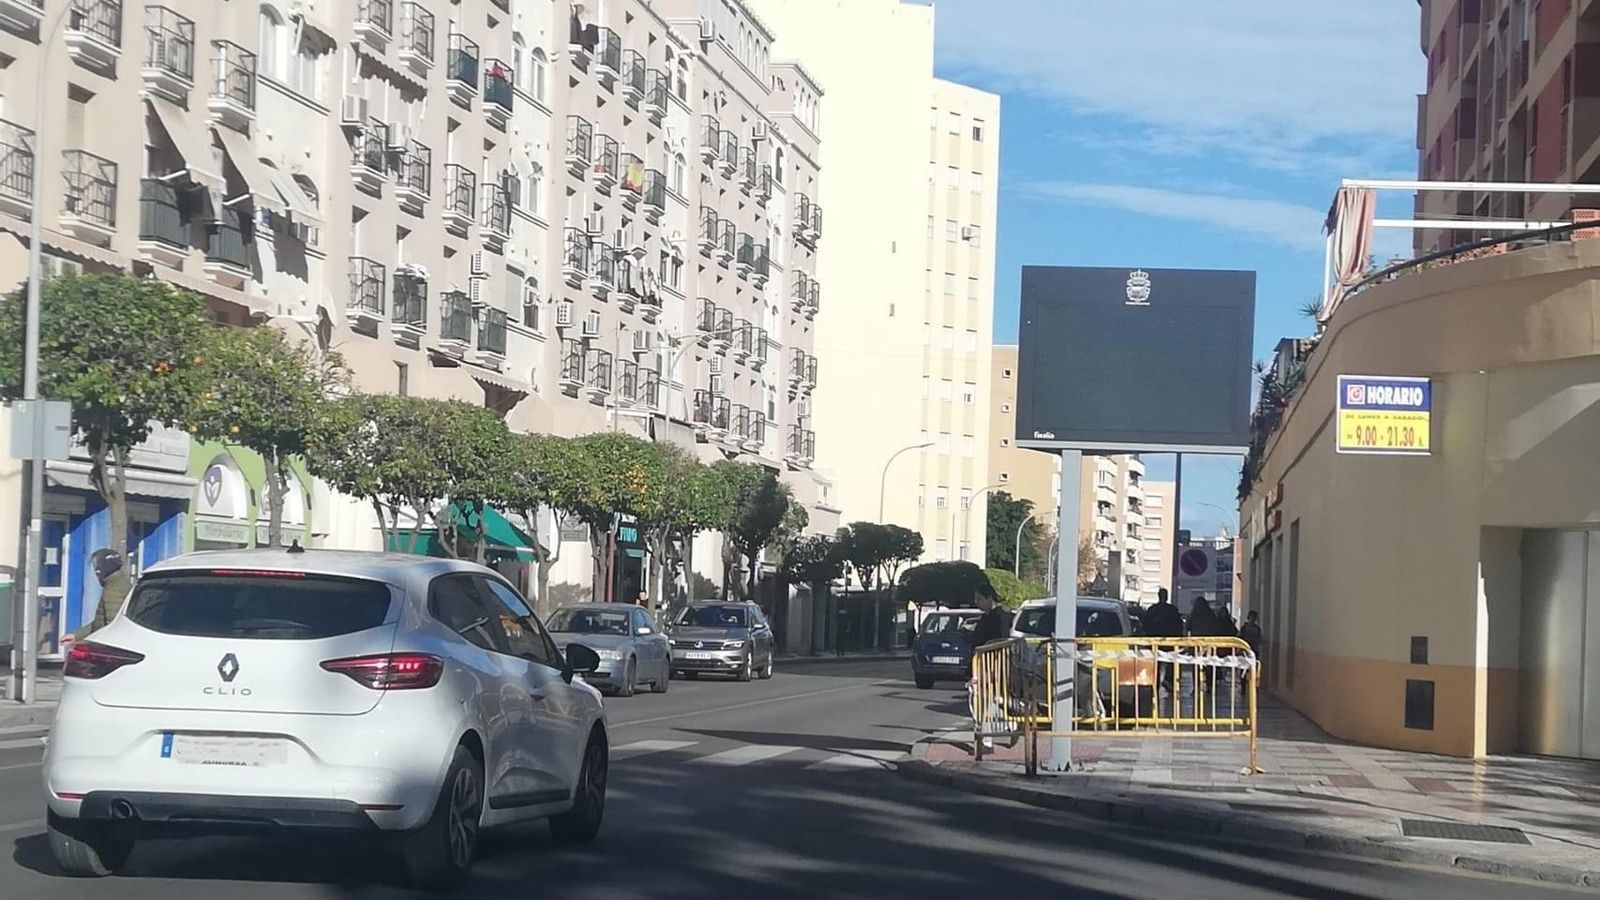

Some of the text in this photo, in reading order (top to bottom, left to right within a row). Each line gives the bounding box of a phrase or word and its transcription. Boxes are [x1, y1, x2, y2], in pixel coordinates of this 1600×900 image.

[1367, 386, 1423, 406] HORARIO
[1356, 425, 1377, 446] 9.00
[1387, 426, 1415, 448] 21.30
[202, 686, 252, 696] CLIO
